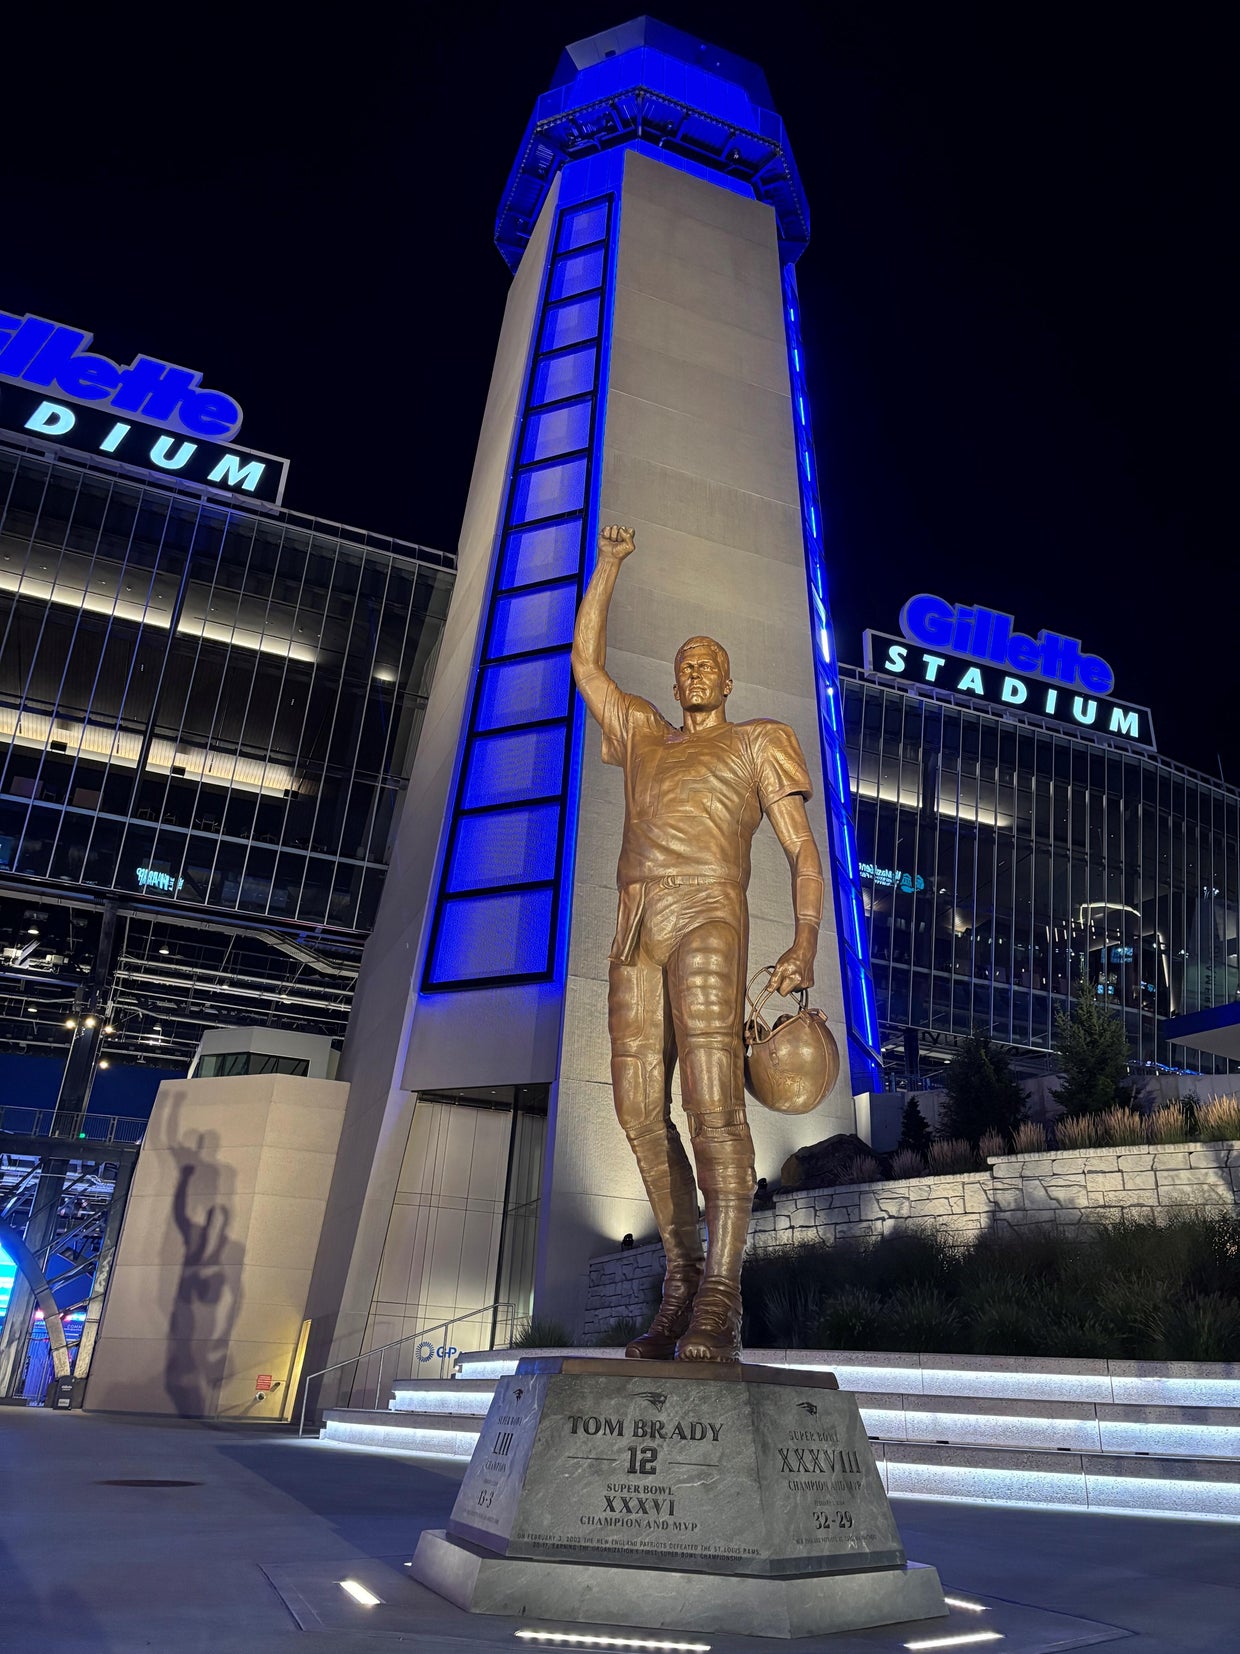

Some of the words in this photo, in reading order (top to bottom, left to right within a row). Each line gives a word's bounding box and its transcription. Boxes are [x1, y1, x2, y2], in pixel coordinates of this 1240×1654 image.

[0, 312, 239, 436] illette
[24, 400, 266, 492] DIUM
[905, 595, 1114, 694] Gillette
[884, 644, 1139, 738] STADIUM
[568, 1416, 624, 1437] TOM
[632, 1418, 724, 1441] BRADY
[789, 1430, 815, 1441] SUPER
[492, 1431, 514, 1456] LIII
[626, 1445, 658, 1475] 12
[778, 1448, 862, 1474] XXXVIII
[606, 1483, 641, 1494] SUPER
[643, 1485, 674, 1495] BOWL
[788, 1480, 829, 1492] CHAMPION
[603, 1495, 676, 1516] XXXVI
[580, 1515, 642, 1528] CHAMPION
[644, 1520, 669, 1530] AND
[673, 1521, 698, 1532] MVP
[812, 1511, 853, 1530] 32-29
[611, 1539, 638, 1547] ENGLAND
[640, 1541, 667, 1549] PATRIOTS
[669, 1543, 698, 1551] DEFEATED
[701, 1544, 712, 1552] THE
